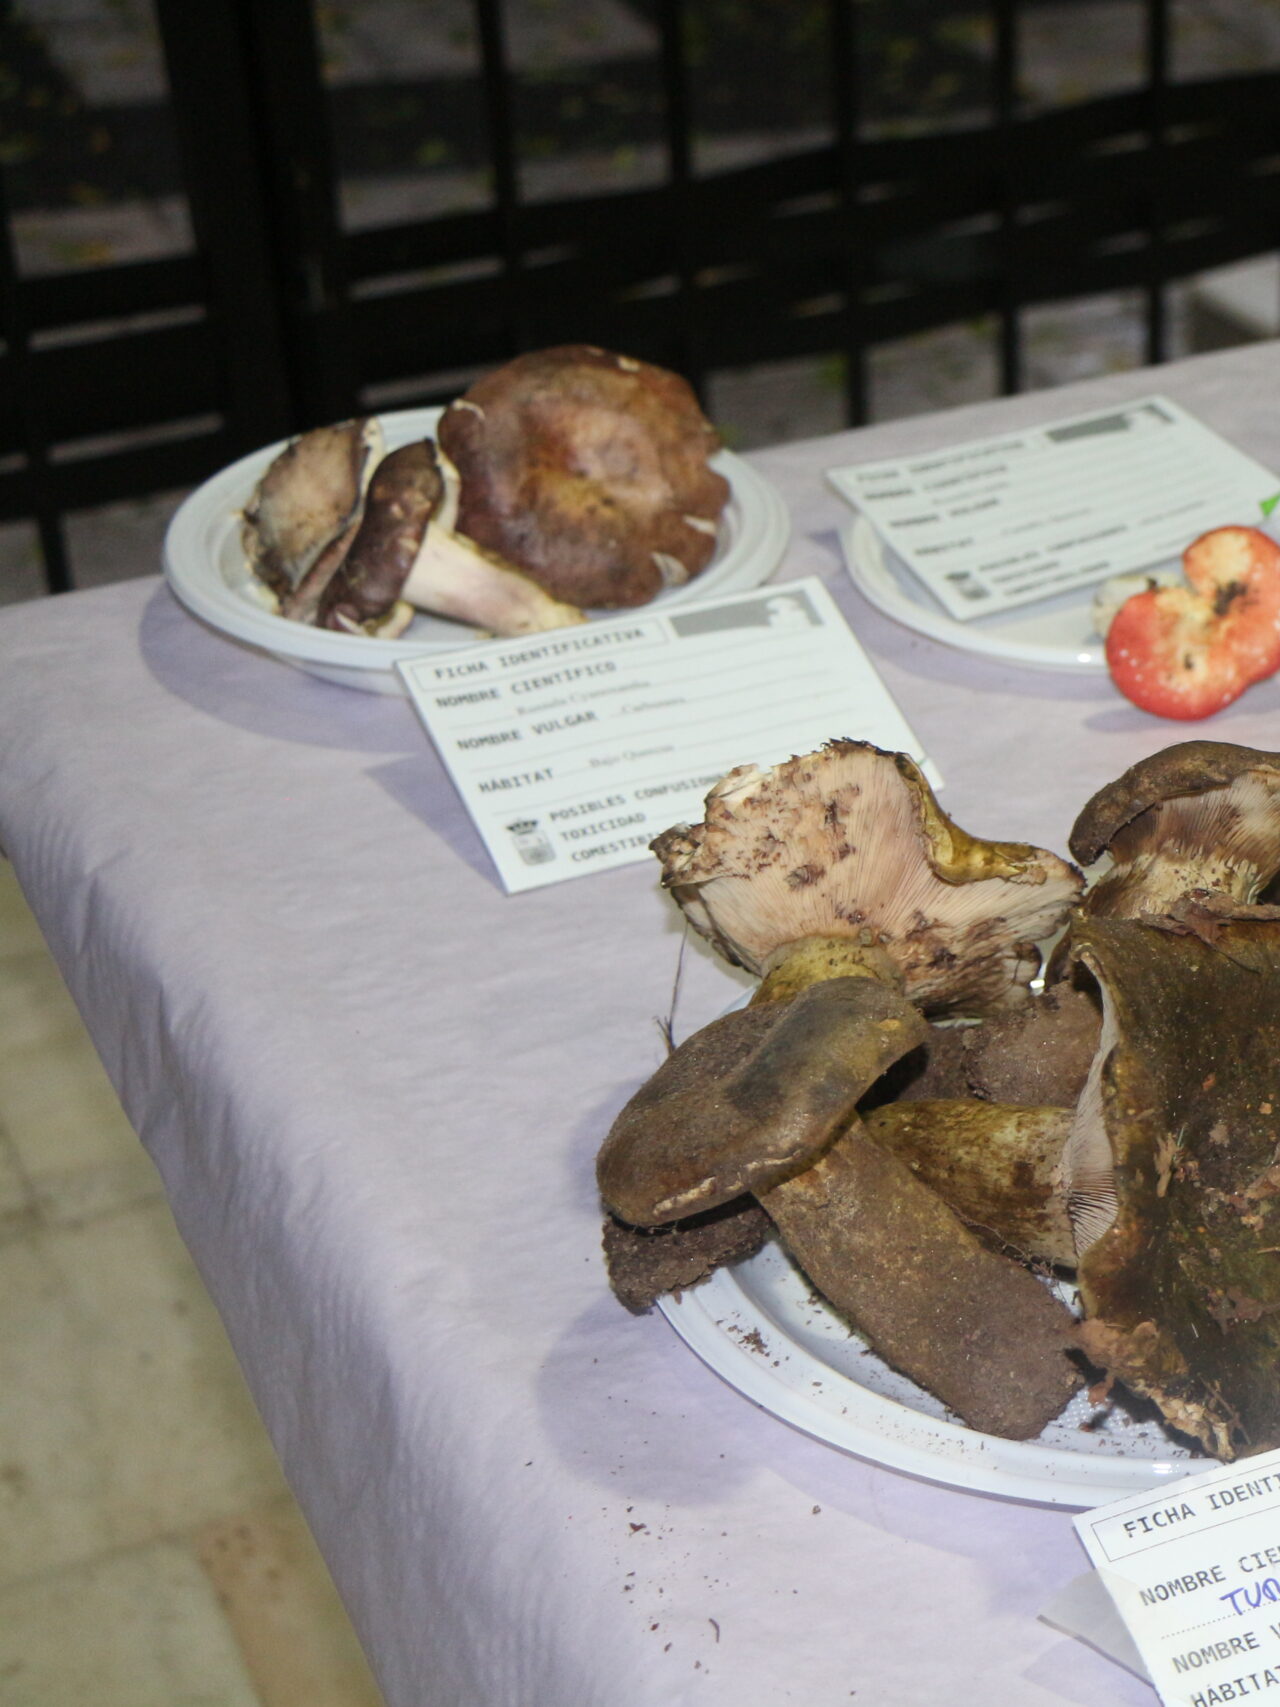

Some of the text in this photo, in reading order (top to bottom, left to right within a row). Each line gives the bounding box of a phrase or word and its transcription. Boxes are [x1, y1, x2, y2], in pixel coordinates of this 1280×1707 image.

[434, 628, 645, 680] FICHA IDENTIFICATIVA
[436, 688, 501, 709] NOMBRE
[457, 710, 598, 751] NOMBRE VULGAR
[549, 773, 725, 822] POSIBLES CONFUSION
[559, 812, 646, 842] TOXICIDAD
[1123, 1503, 1197, 1539] FICHA
[1138, 1565, 1227, 1607] NOMBRE
[1172, 1631, 1261, 1674] NOMBRE
